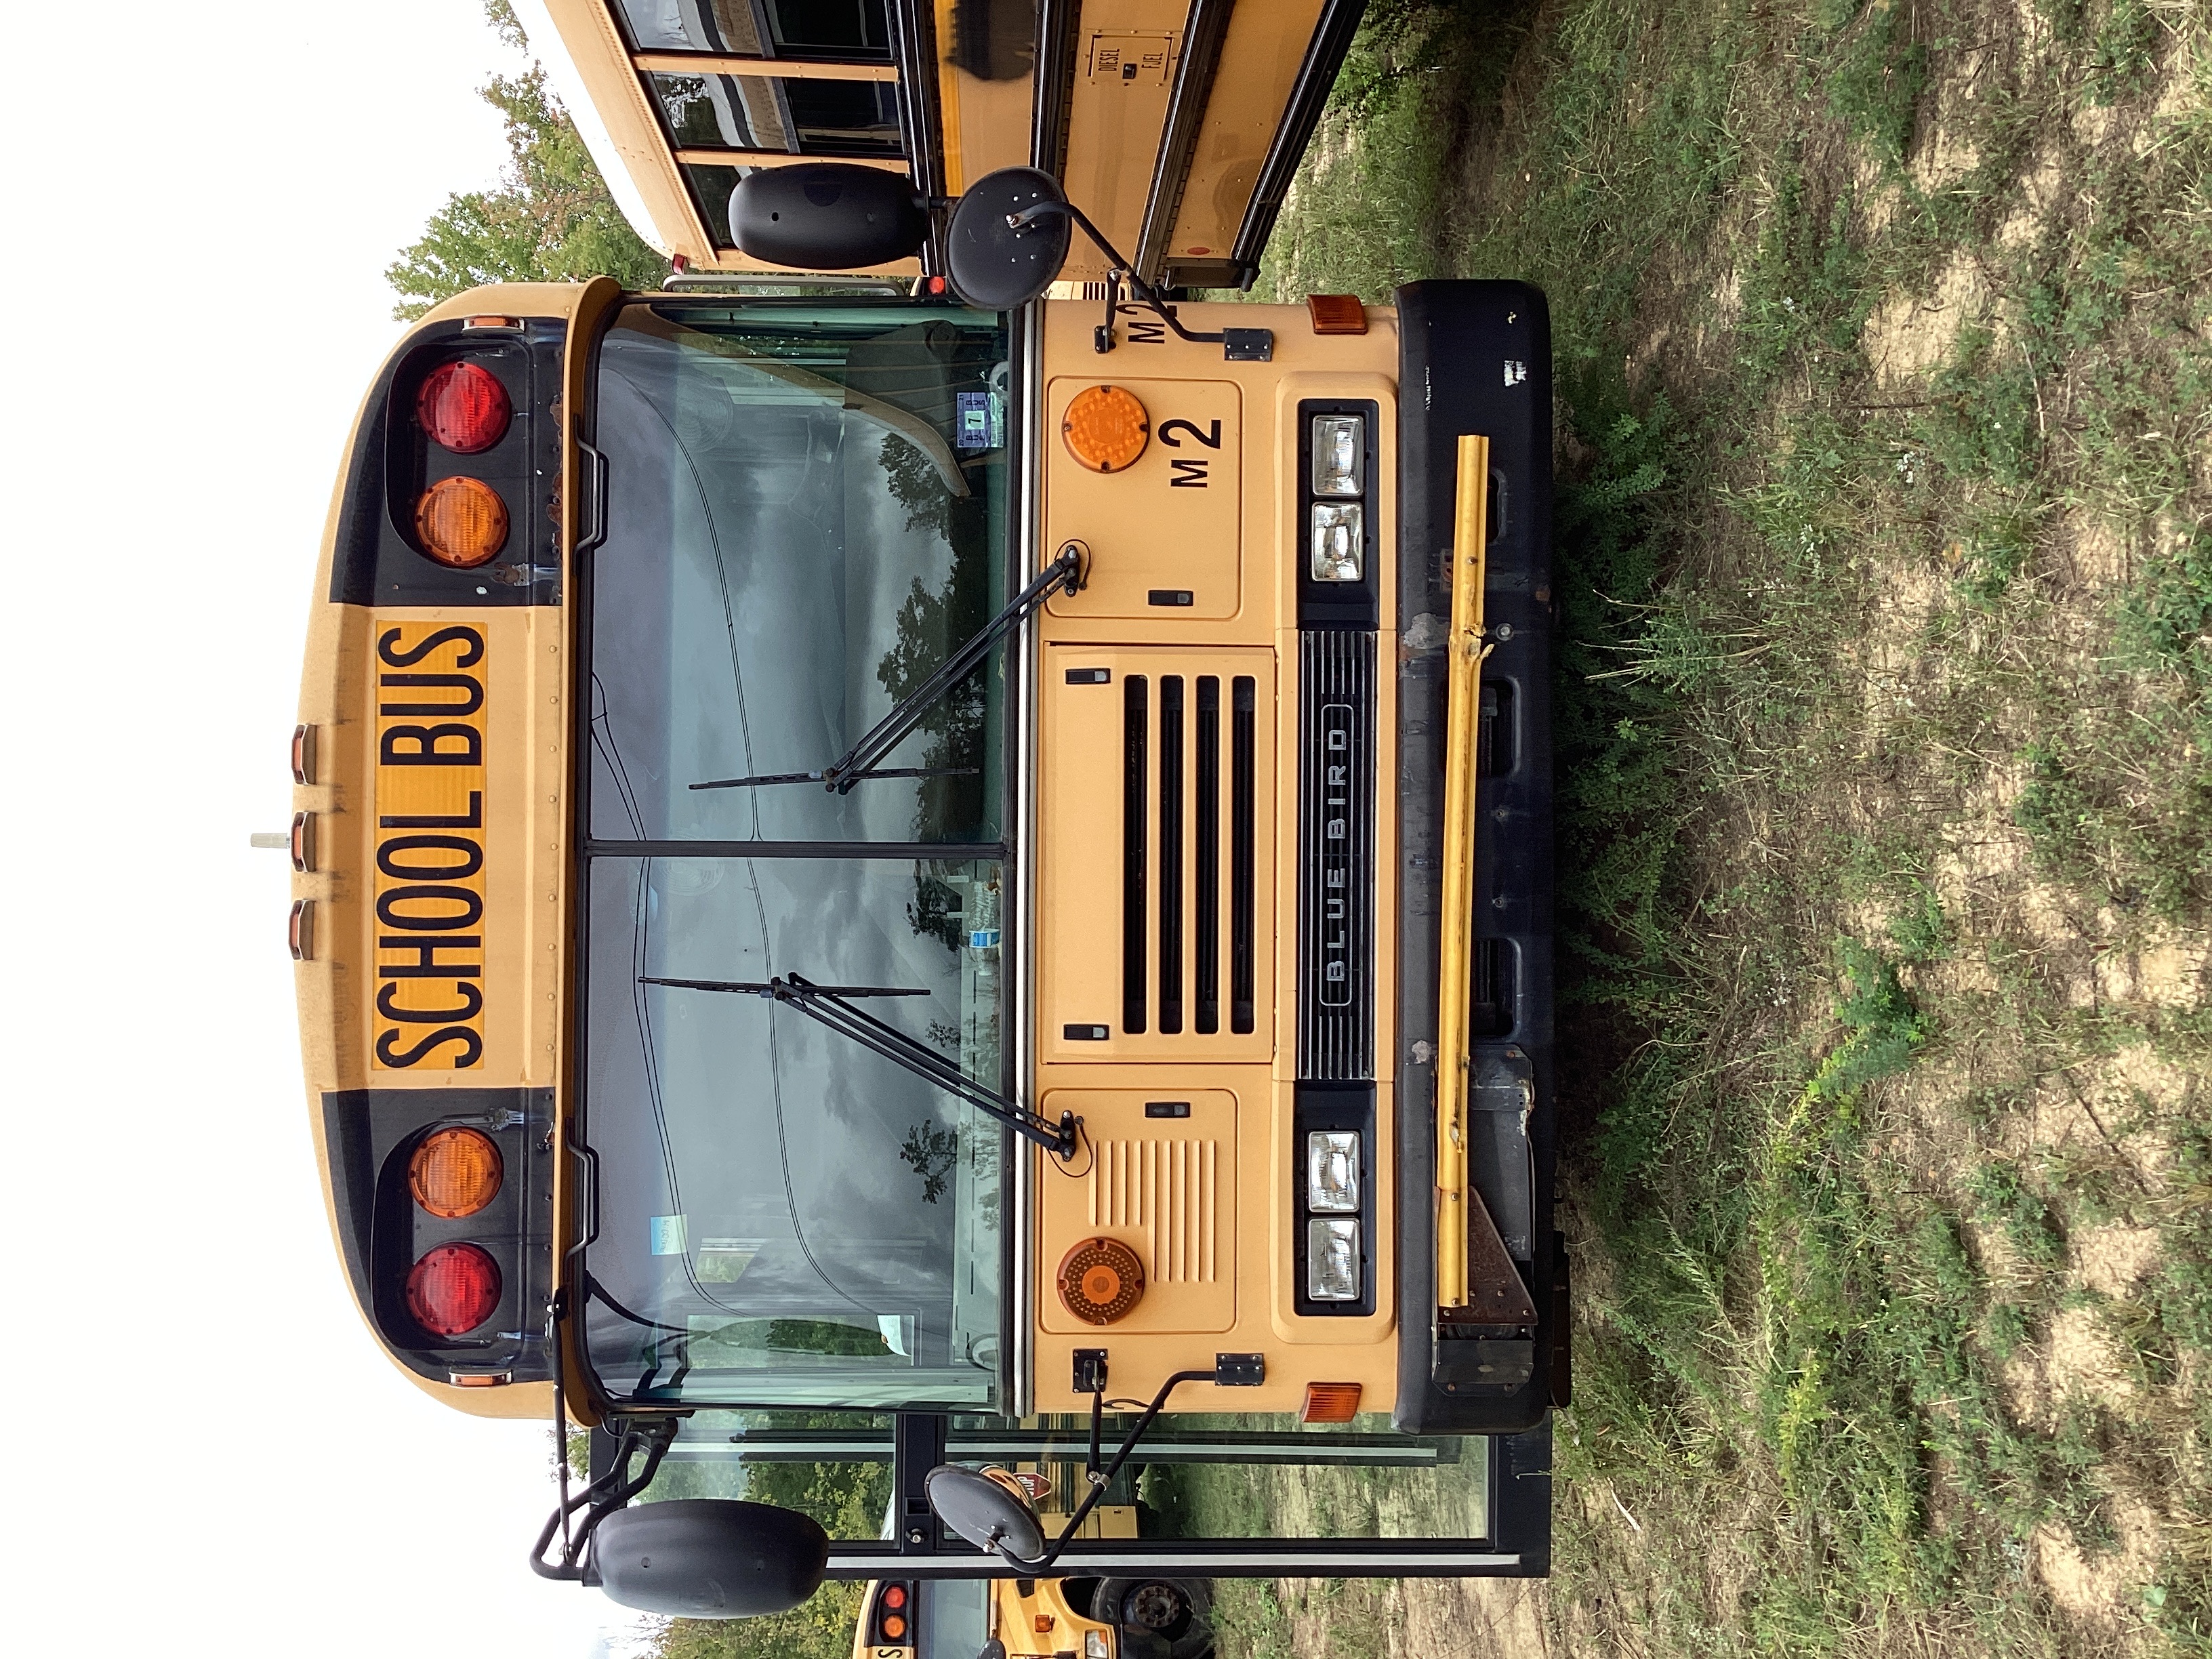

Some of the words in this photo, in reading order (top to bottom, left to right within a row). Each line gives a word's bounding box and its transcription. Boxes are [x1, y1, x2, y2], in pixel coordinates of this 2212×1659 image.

[1098, 48, 1120, 72] DIESEL
[1141, 52, 1164, 69] FUEL
[377, 626, 485, 767] BUS
[1327, 729, 1347, 840] BIRD
[375, 790, 483, 1069] SCHOOL
[1326, 867, 1345, 981] BLUE
[1017, 1476, 1035, 1496] OP
